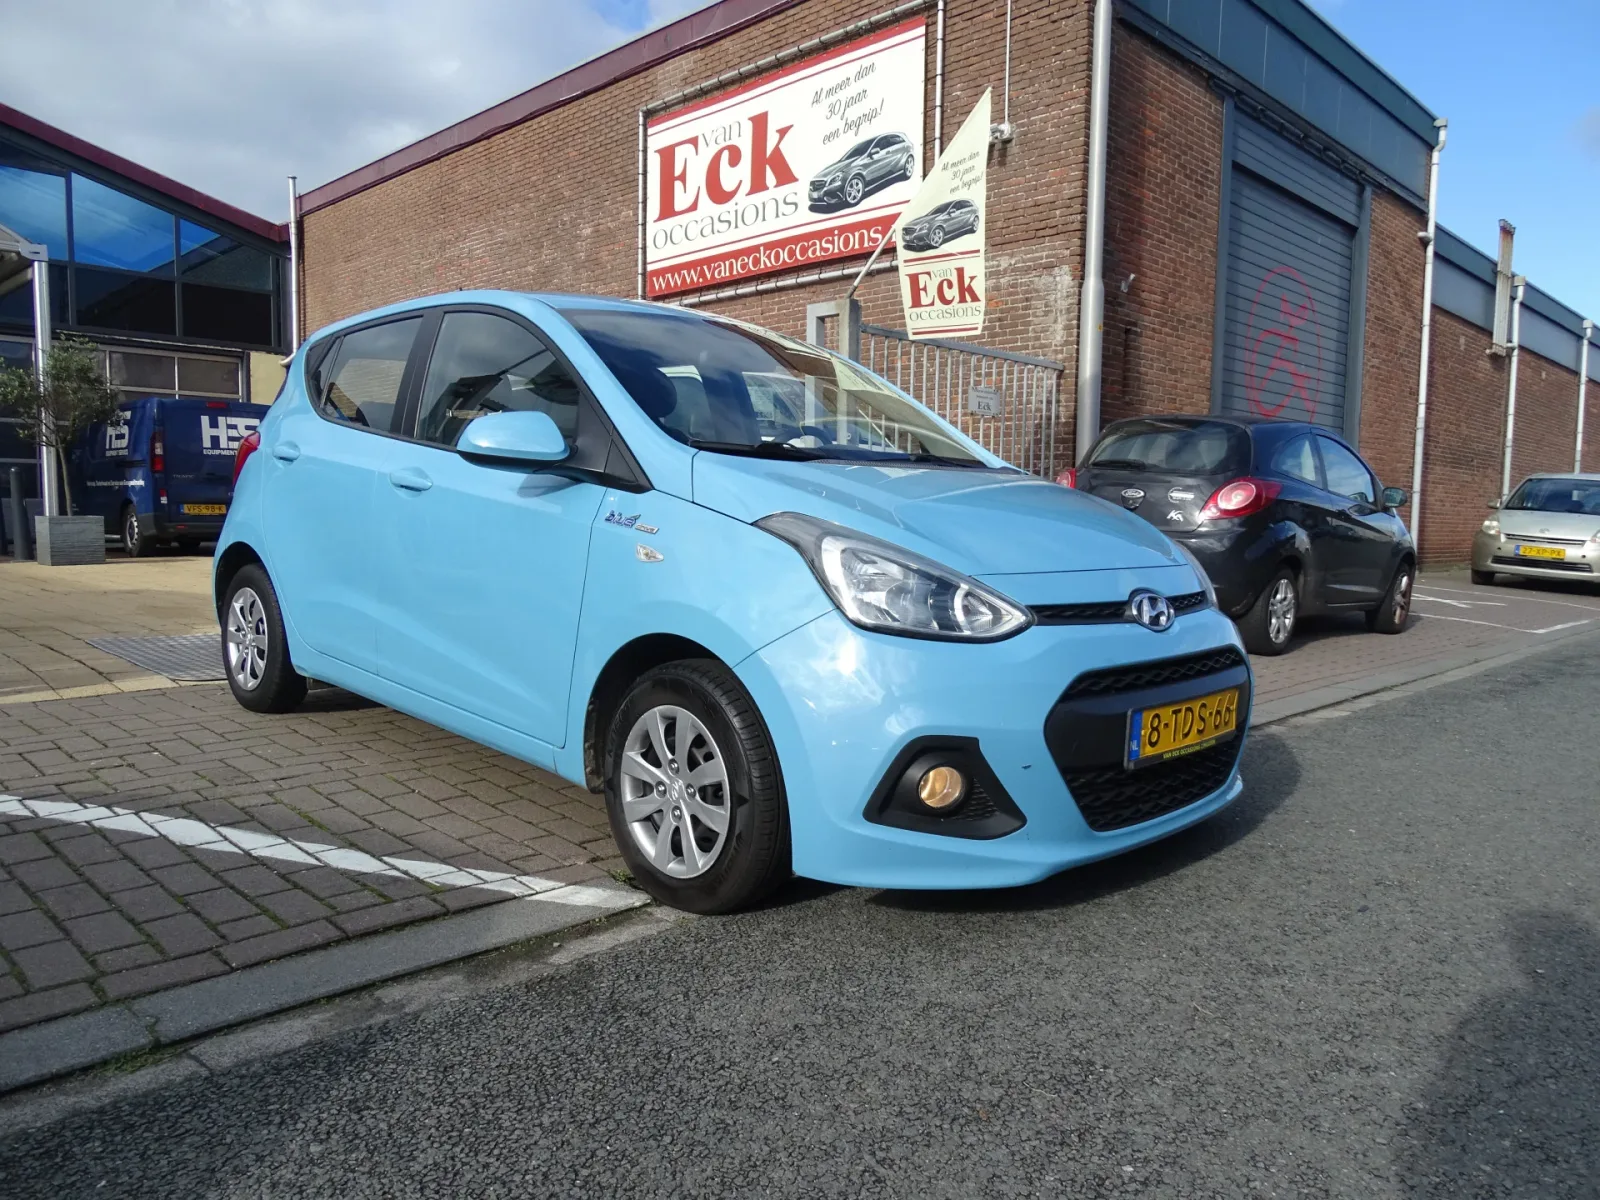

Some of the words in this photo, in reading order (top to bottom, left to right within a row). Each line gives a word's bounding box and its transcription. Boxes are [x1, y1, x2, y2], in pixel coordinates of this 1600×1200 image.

[811, 87, 824, 108] Al
[825, 76, 852, 100] meer
[854, 62, 876, 83] dan
[826, 98, 842, 120] 30
[840, 88, 868, 121] jaar
[701, 120, 742, 149] van
[822, 128, 841, 146] een
[843, 97, 885, 137] begrip!
[653, 111, 799, 223] Eck
[941, 161, 949, 172] Al
[950, 157, 967, 169] meer
[951, 169, 961, 181] 30
[960, 165, 975, 182] jaar
[652, 191, 799, 250] occasions
[652, 225, 897, 291] www.vaneckoccasions
[932, 267, 953, 278] van
[904, 266, 982, 309] Eck
[909, 305, 982, 322] occasions
[1146, 693, 1232, 748] 8-TDS-66
